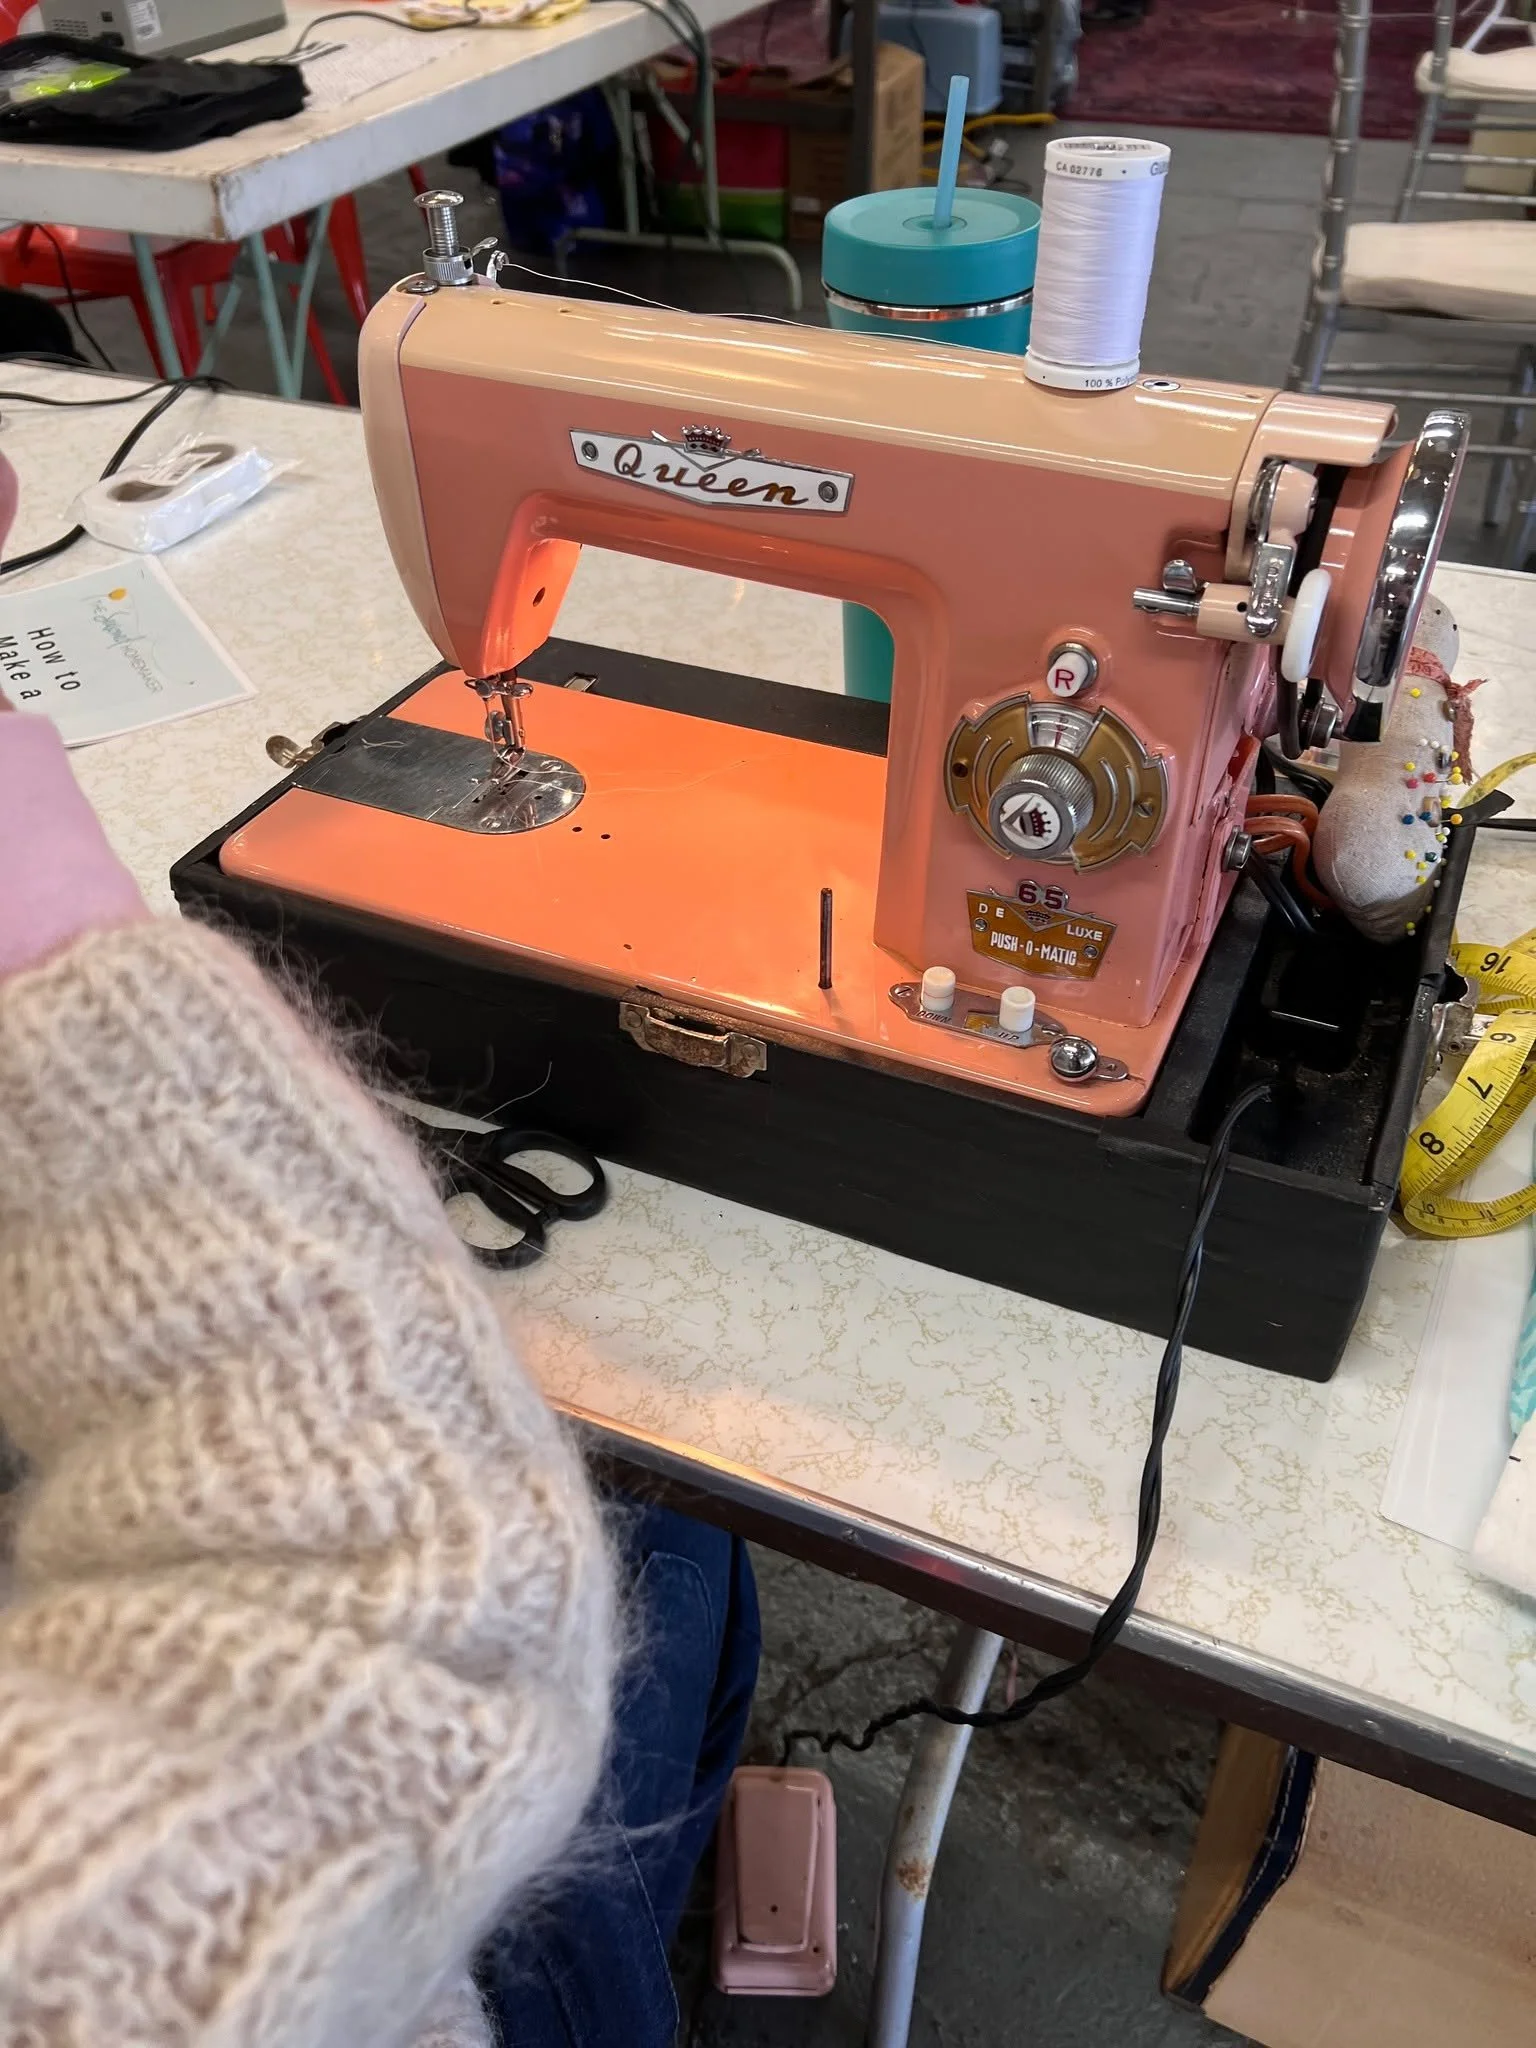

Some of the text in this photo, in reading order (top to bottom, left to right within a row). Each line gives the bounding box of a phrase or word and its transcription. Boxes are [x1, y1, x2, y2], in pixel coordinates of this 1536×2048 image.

[1056, 161, 1067, 172] CA
[1085, 379, 1102, 388] 100
[1105, 379, 1113, 388] %
[614, 442, 809, 505] Queen
[0, 635, 42, 700] Make a
[27, 627, 81, 691] How to
[1054, 668, 1075, 690] R
[1018, 883, 1063, 910] 65
[1066, 924, 1103, 941] LUXE
[1479, 952, 1512, 975] 16
[916, 1010, 952, 1023] DOWN
[1490, 1032, 1517, 1043] 6
[1467, 1076, 1494, 1100] 7
[1419, 1131, 1445, 1155] 8
